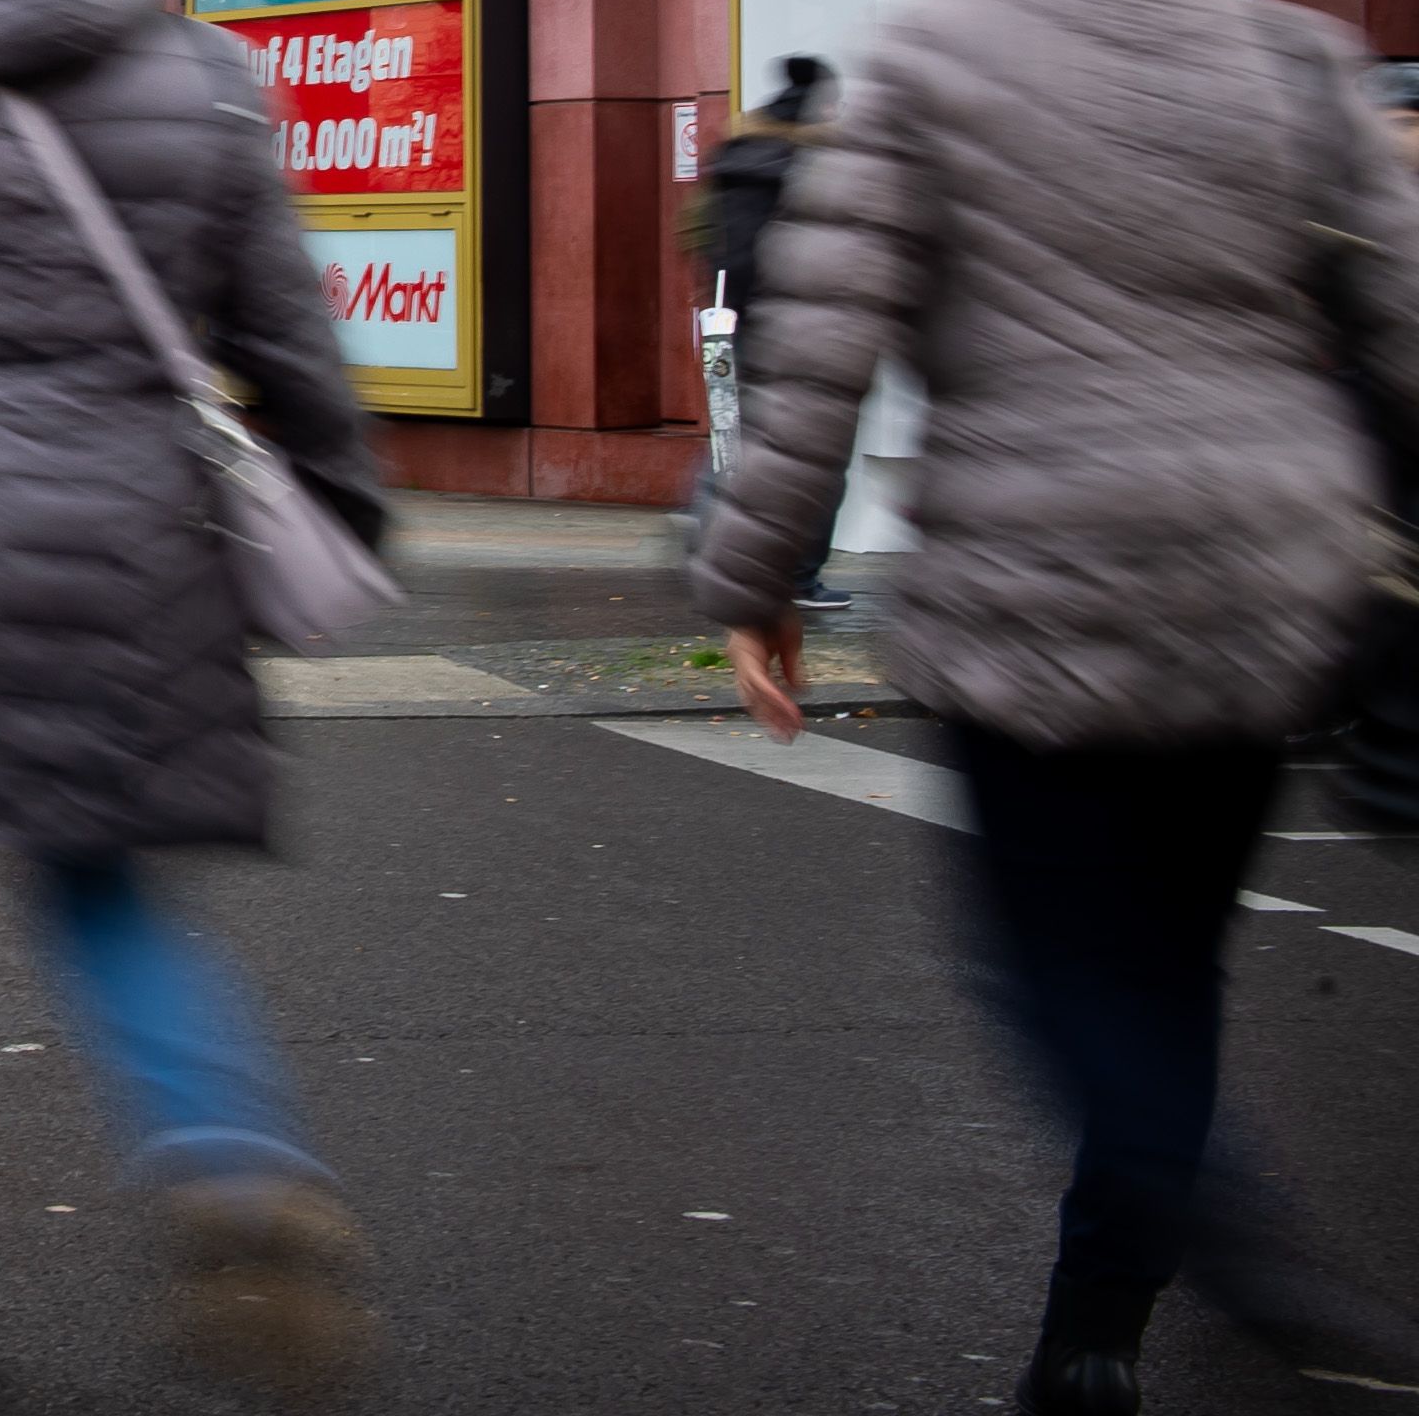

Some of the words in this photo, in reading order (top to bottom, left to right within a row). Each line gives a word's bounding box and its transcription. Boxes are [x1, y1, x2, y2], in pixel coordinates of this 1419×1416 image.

[282, 37, 304, 86] 4
[305, 29, 413, 93] Etagen
[291, 117, 378, 171] 8.000
[345, 262, 446, 322] Markt
